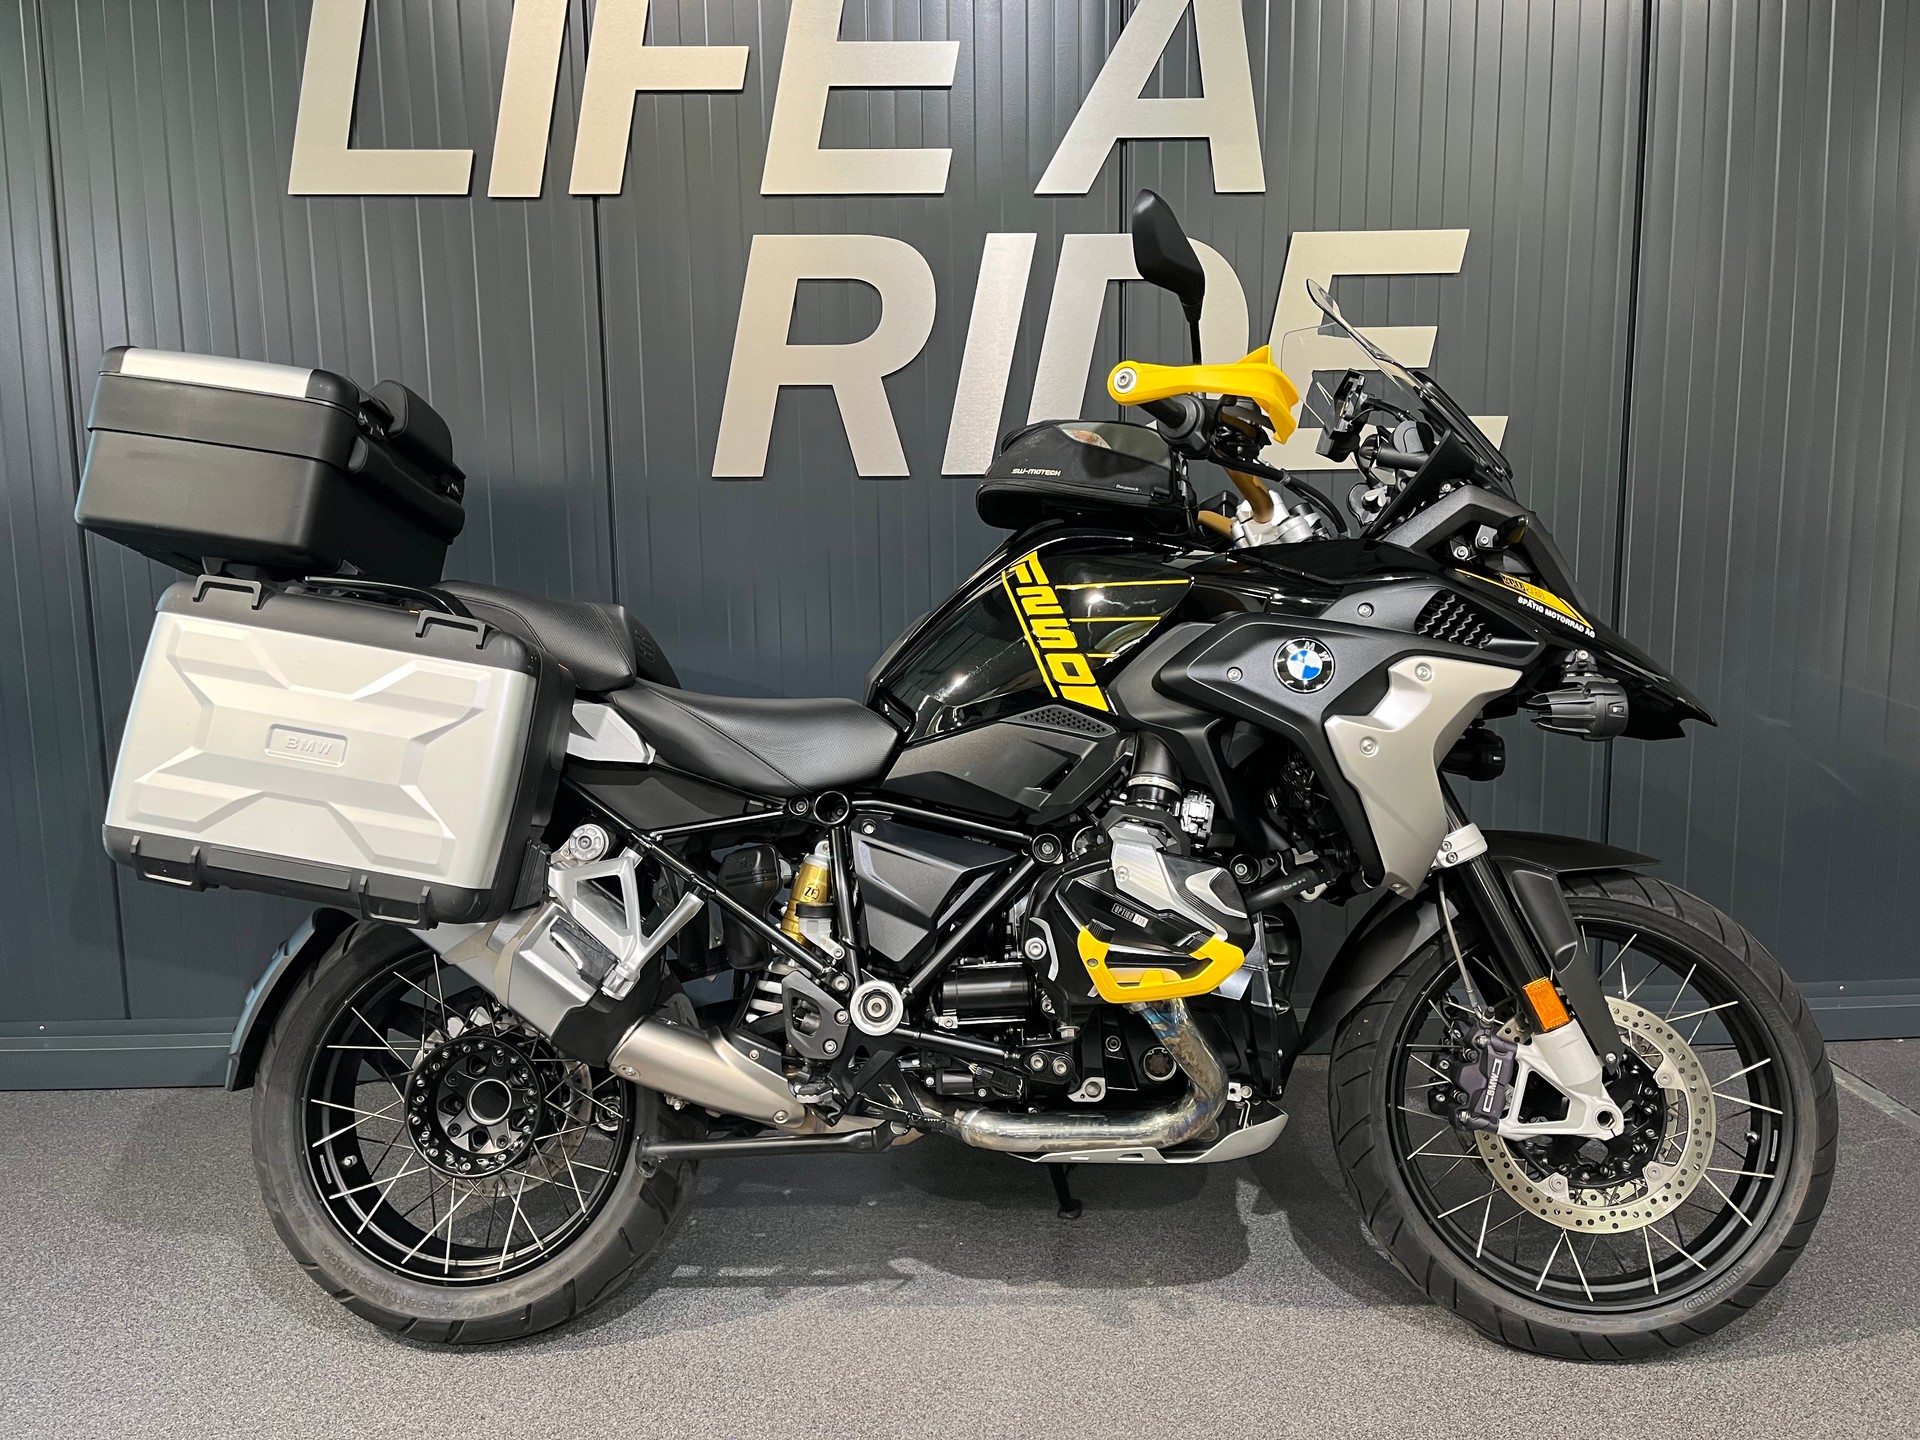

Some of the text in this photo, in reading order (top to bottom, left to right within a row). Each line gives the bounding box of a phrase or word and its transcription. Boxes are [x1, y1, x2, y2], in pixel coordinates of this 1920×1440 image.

[288, 0, 1266, 197] LIFE A
[712, 228, 1508, 478] RIDE
[1011, 468, 1061, 477] SW-MOTECH
[1544, 608, 1585, 633] MOTORRAD
[1285, 640, 1333, 662] BMW
[285, 737, 333, 755] BMW
[804, 886, 819, 899] ZF
[1486, 1072, 1499, 1096] BMW
[1682, 1270, 1742, 1312] Continental
